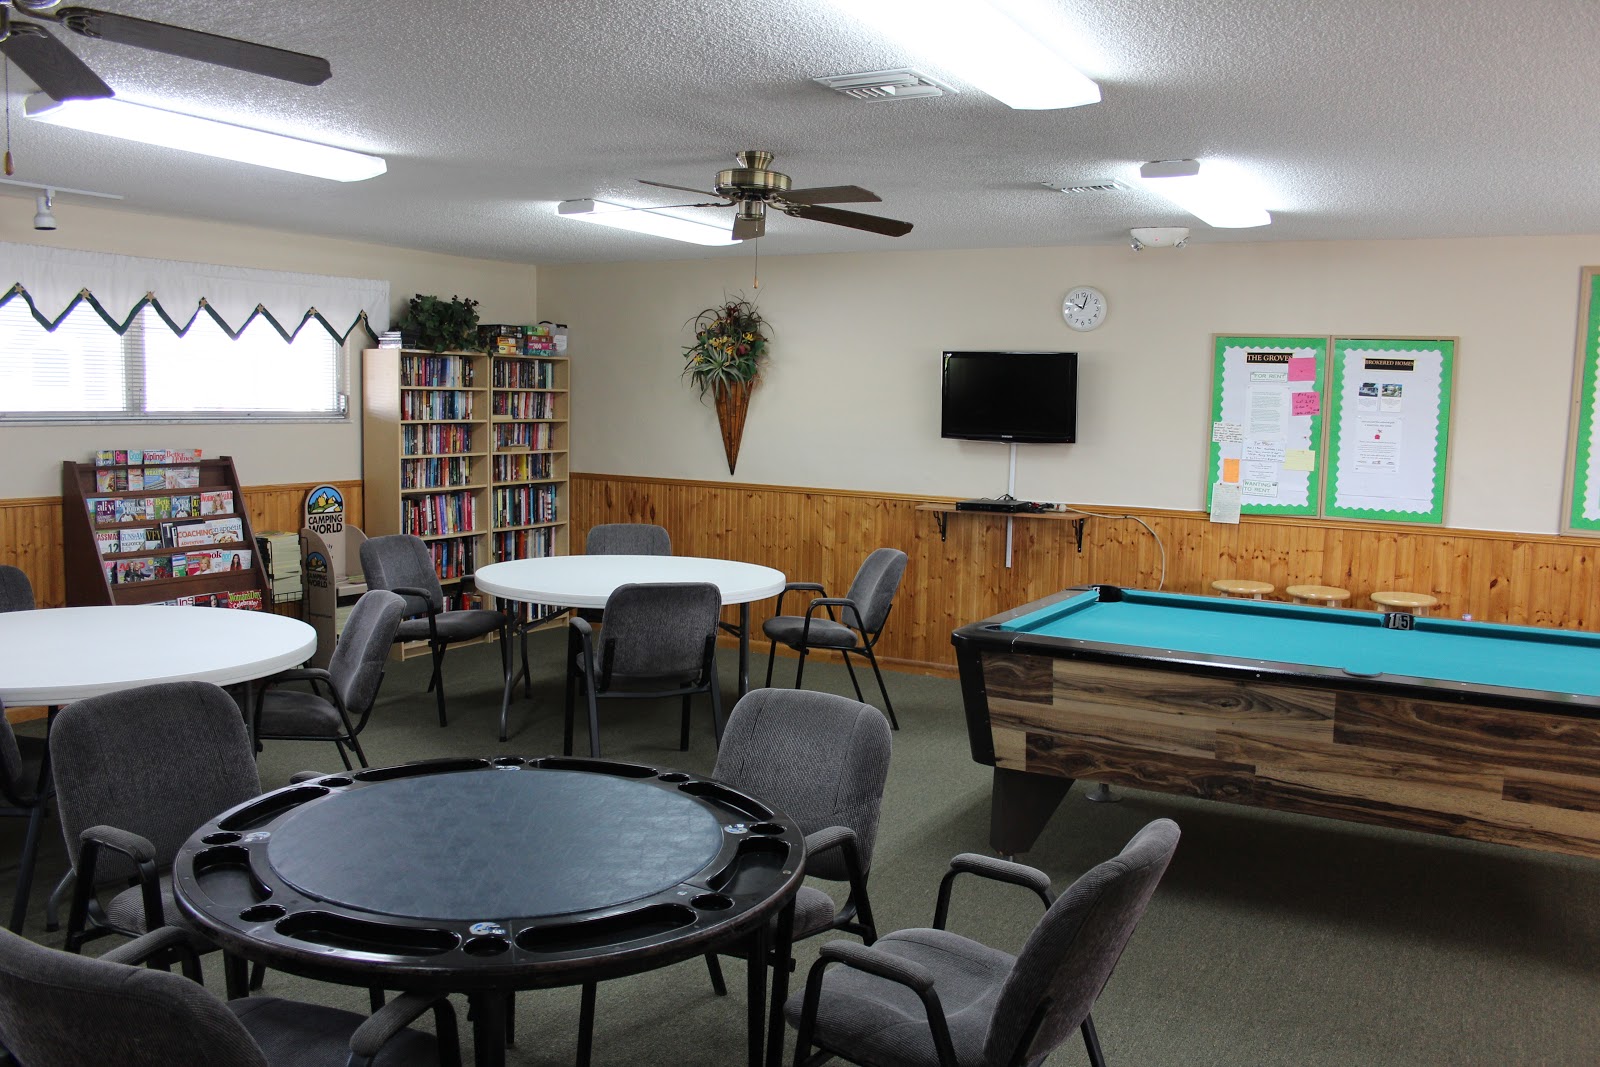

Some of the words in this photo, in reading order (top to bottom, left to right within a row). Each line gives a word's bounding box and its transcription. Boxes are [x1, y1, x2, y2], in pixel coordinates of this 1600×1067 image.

[309, 514, 343, 525] CAMPING
[177, 529, 213, 539] COACHING
[309, 524, 343, 534] WORLD
